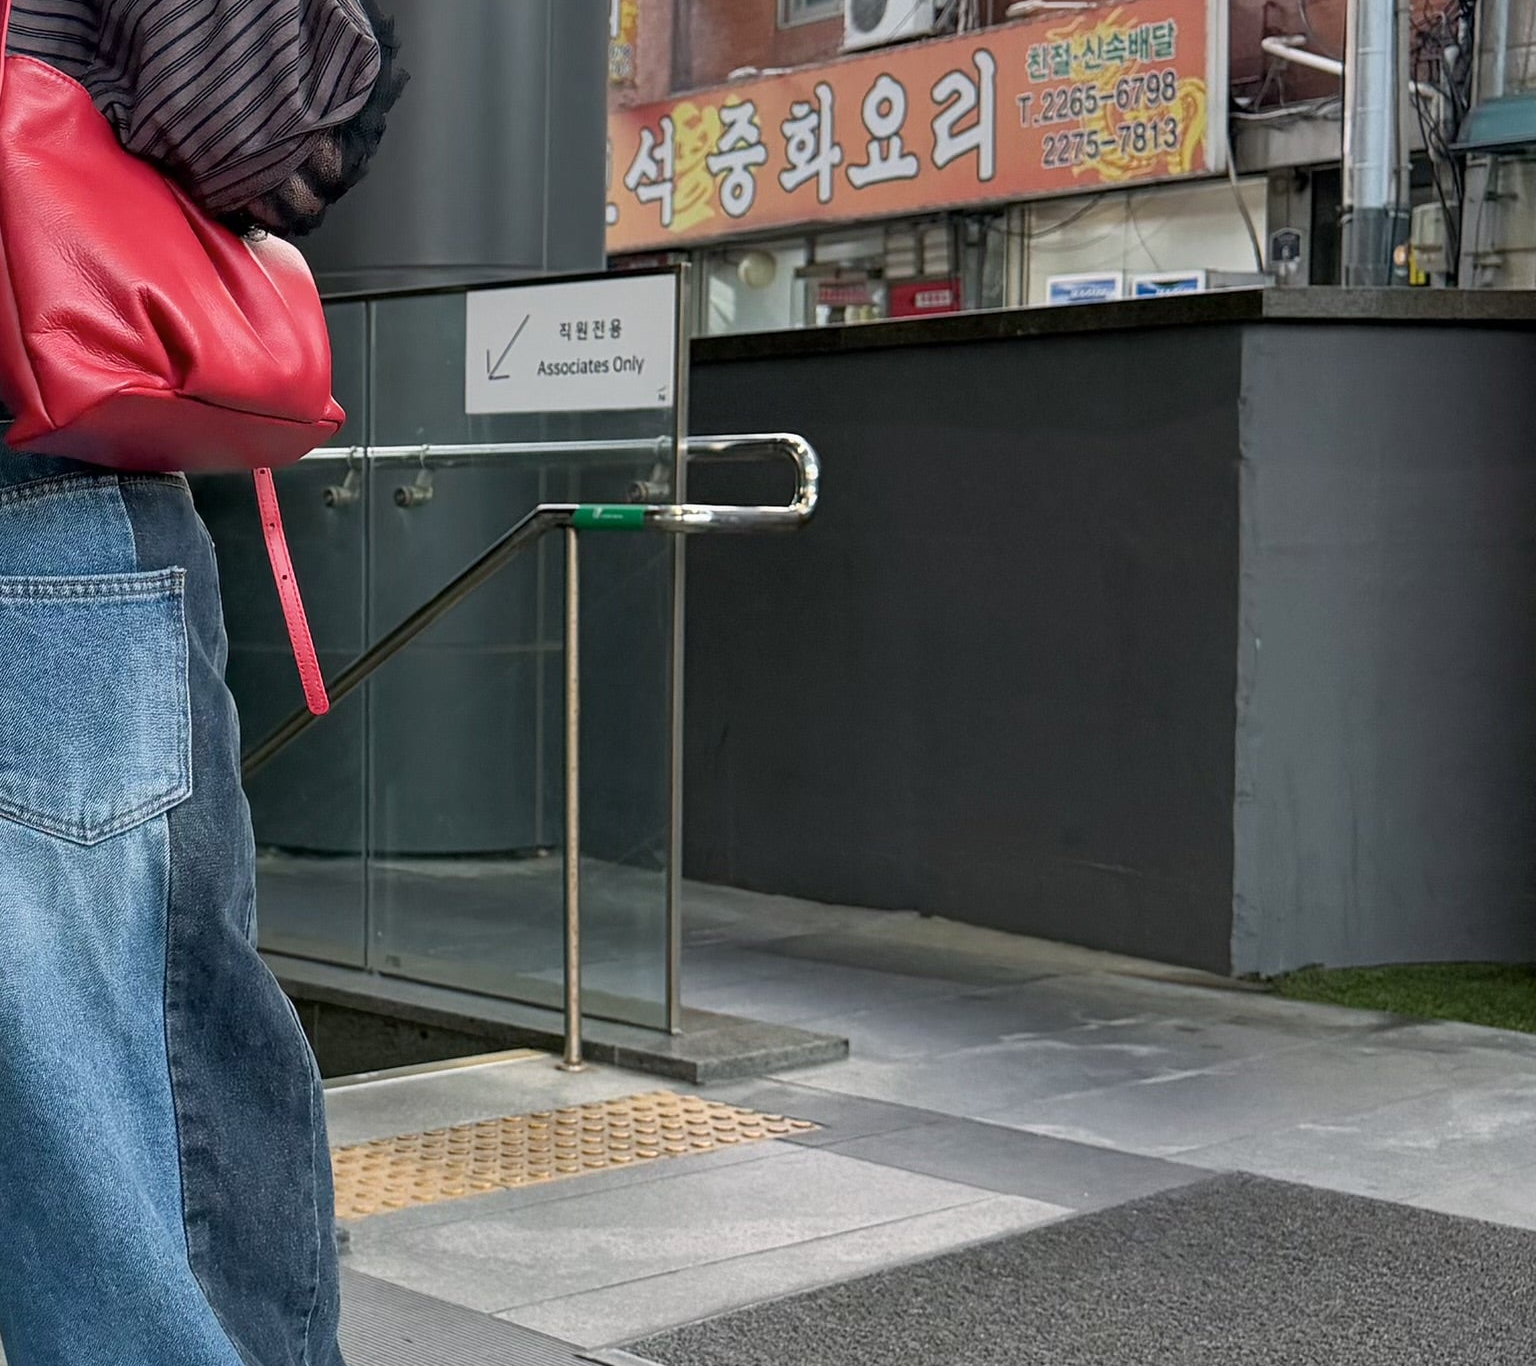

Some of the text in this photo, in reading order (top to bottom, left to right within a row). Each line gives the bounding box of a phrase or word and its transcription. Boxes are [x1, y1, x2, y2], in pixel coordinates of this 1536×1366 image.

[1042, 117, 1178, 167] 2275-7813
[537, 355, 645, 376] Associates Only
